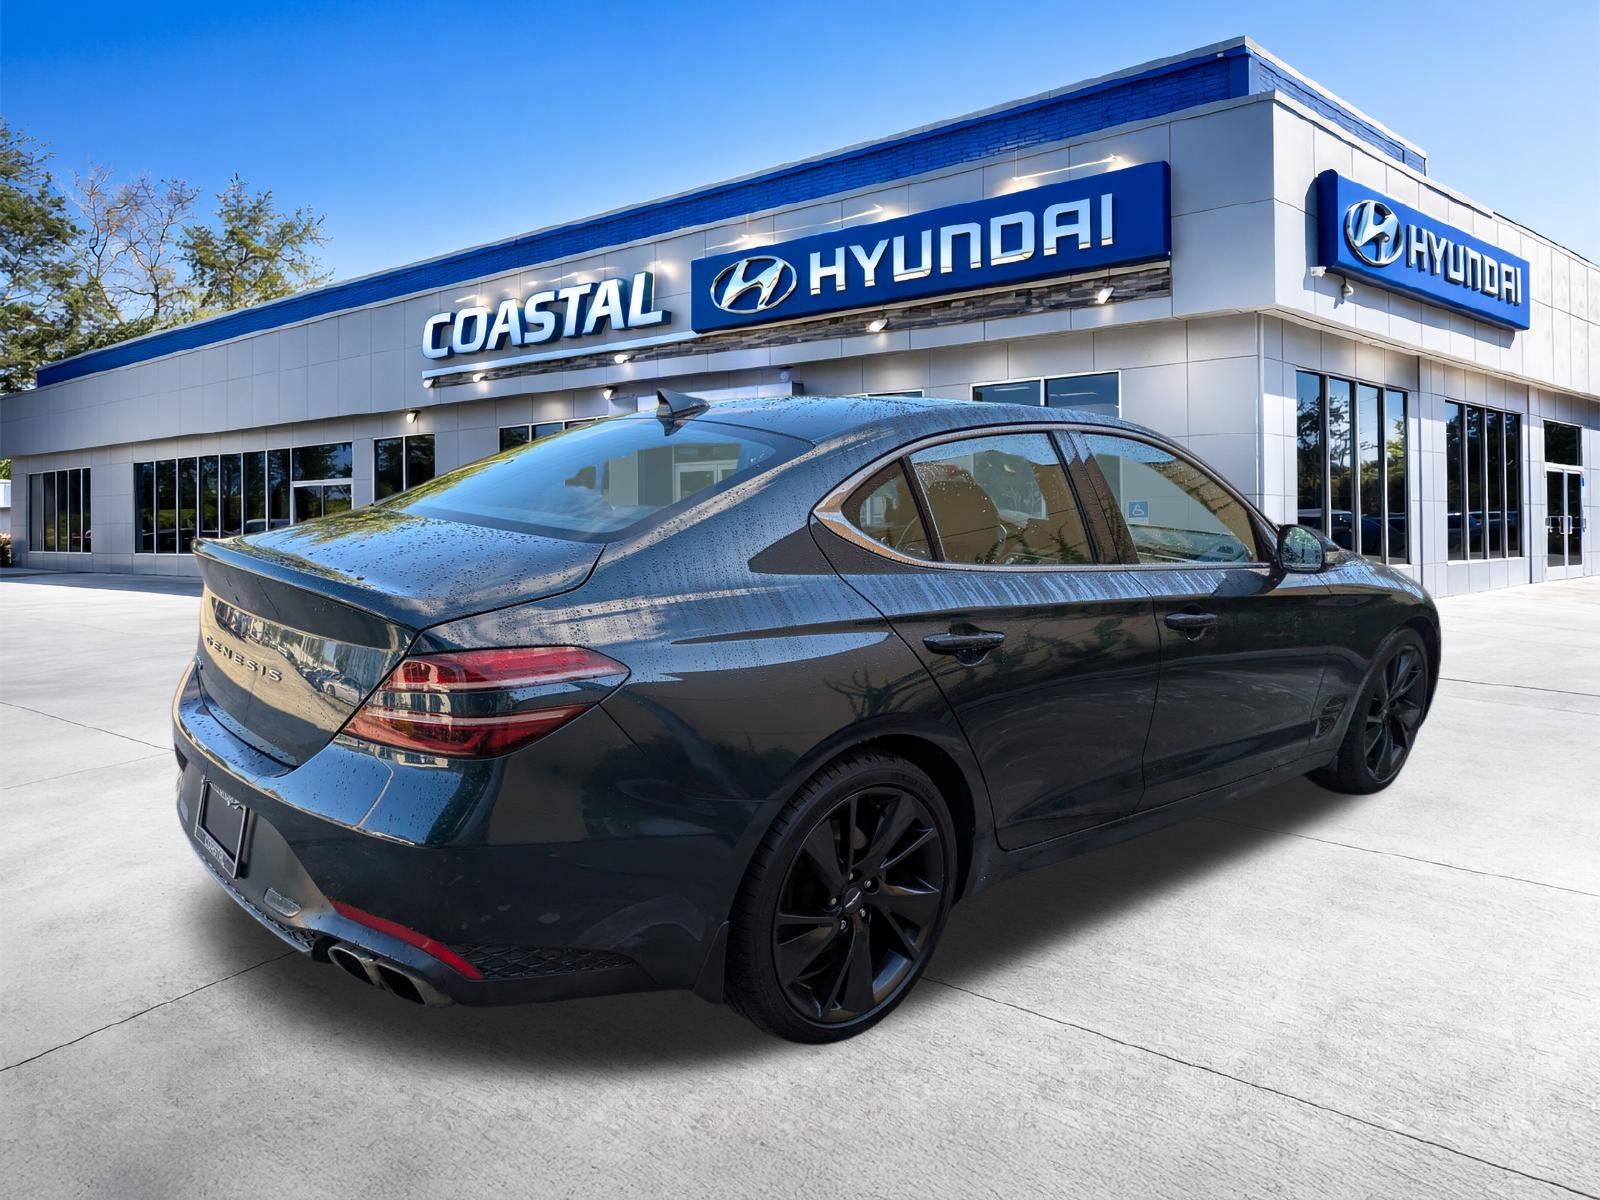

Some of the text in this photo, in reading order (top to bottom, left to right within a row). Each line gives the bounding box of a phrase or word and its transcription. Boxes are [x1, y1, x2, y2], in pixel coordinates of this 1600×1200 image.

[810, 192, 1114, 296] HYUNDAI
[1406, 223, 1523, 307] HYUNDAI
[421, 271, 669, 360] COASTAL
[206, 634, 282, 681] GENESIS
